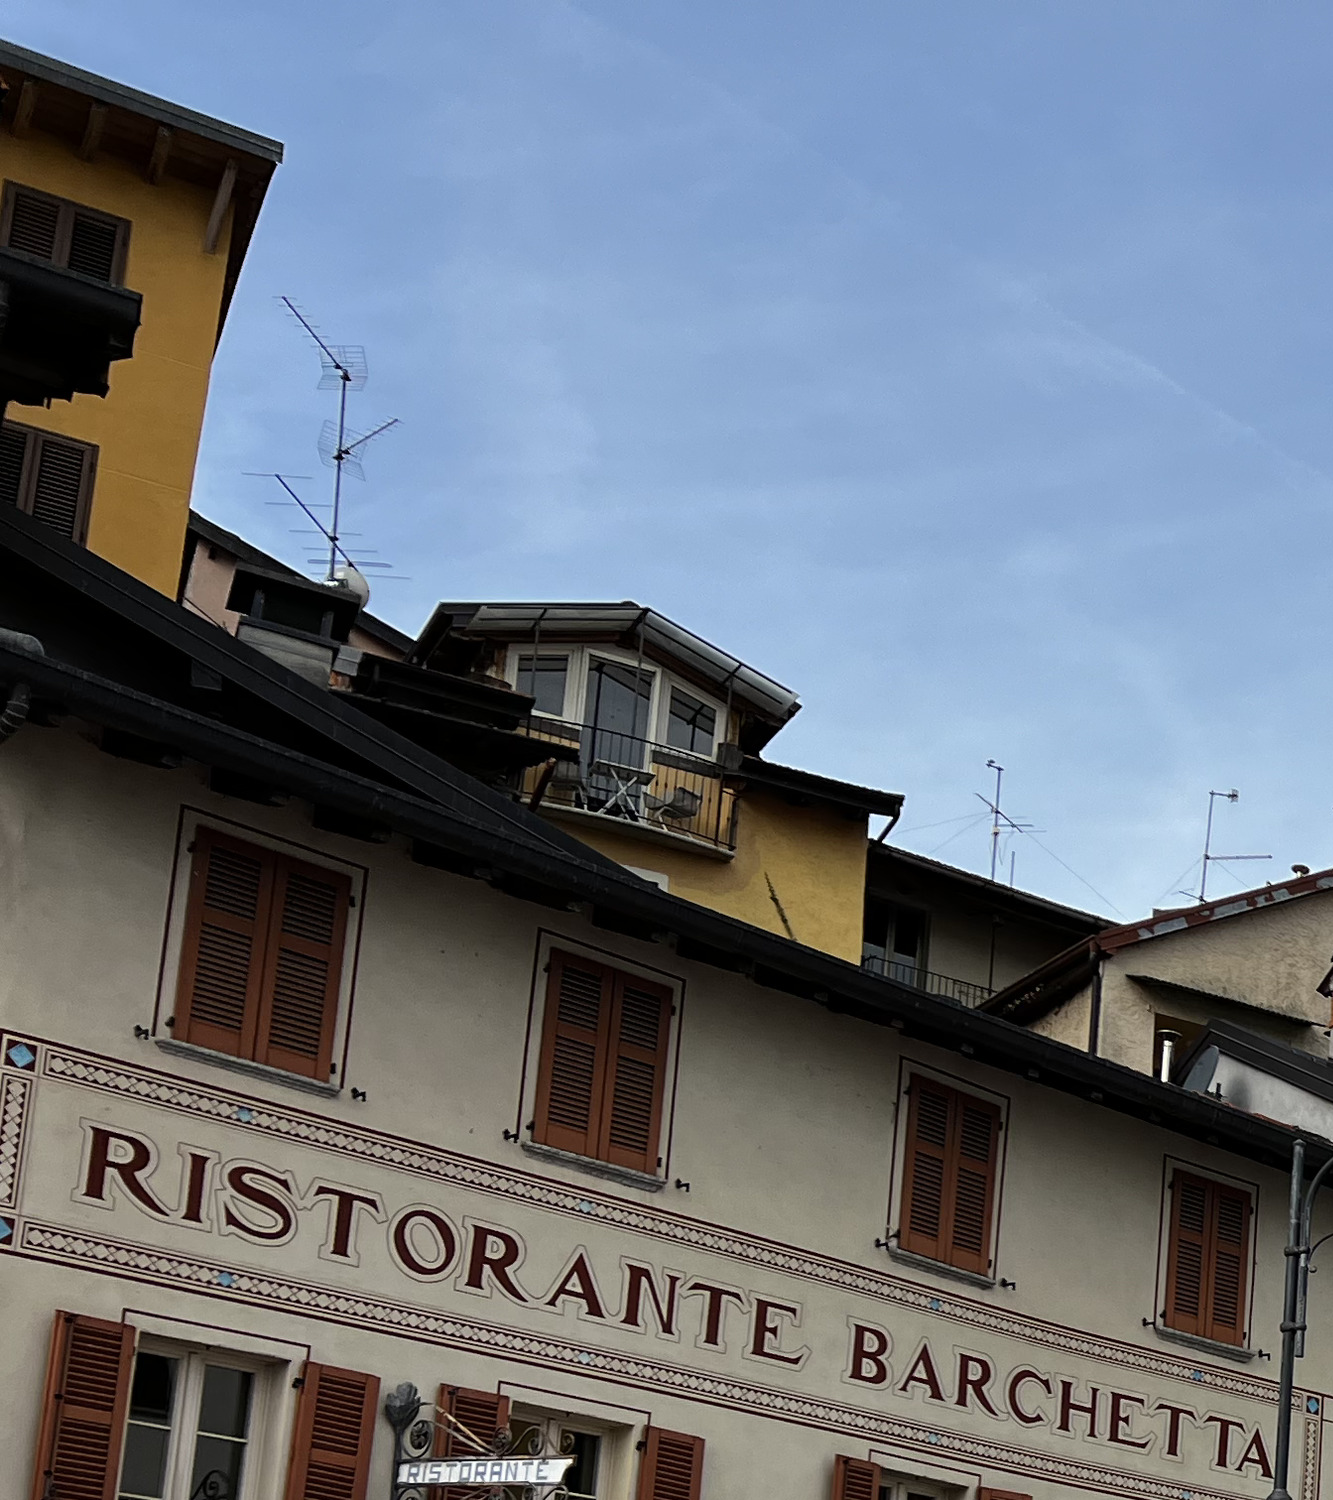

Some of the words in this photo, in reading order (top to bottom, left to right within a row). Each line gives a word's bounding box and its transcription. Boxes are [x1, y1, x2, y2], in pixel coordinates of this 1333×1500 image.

[83, 1125, 803, 1367] RISTORANTE
[848, 1323, 1273, 1479] BARCHETTA
[407, 1460, 550, 1483] RISTORANTE
